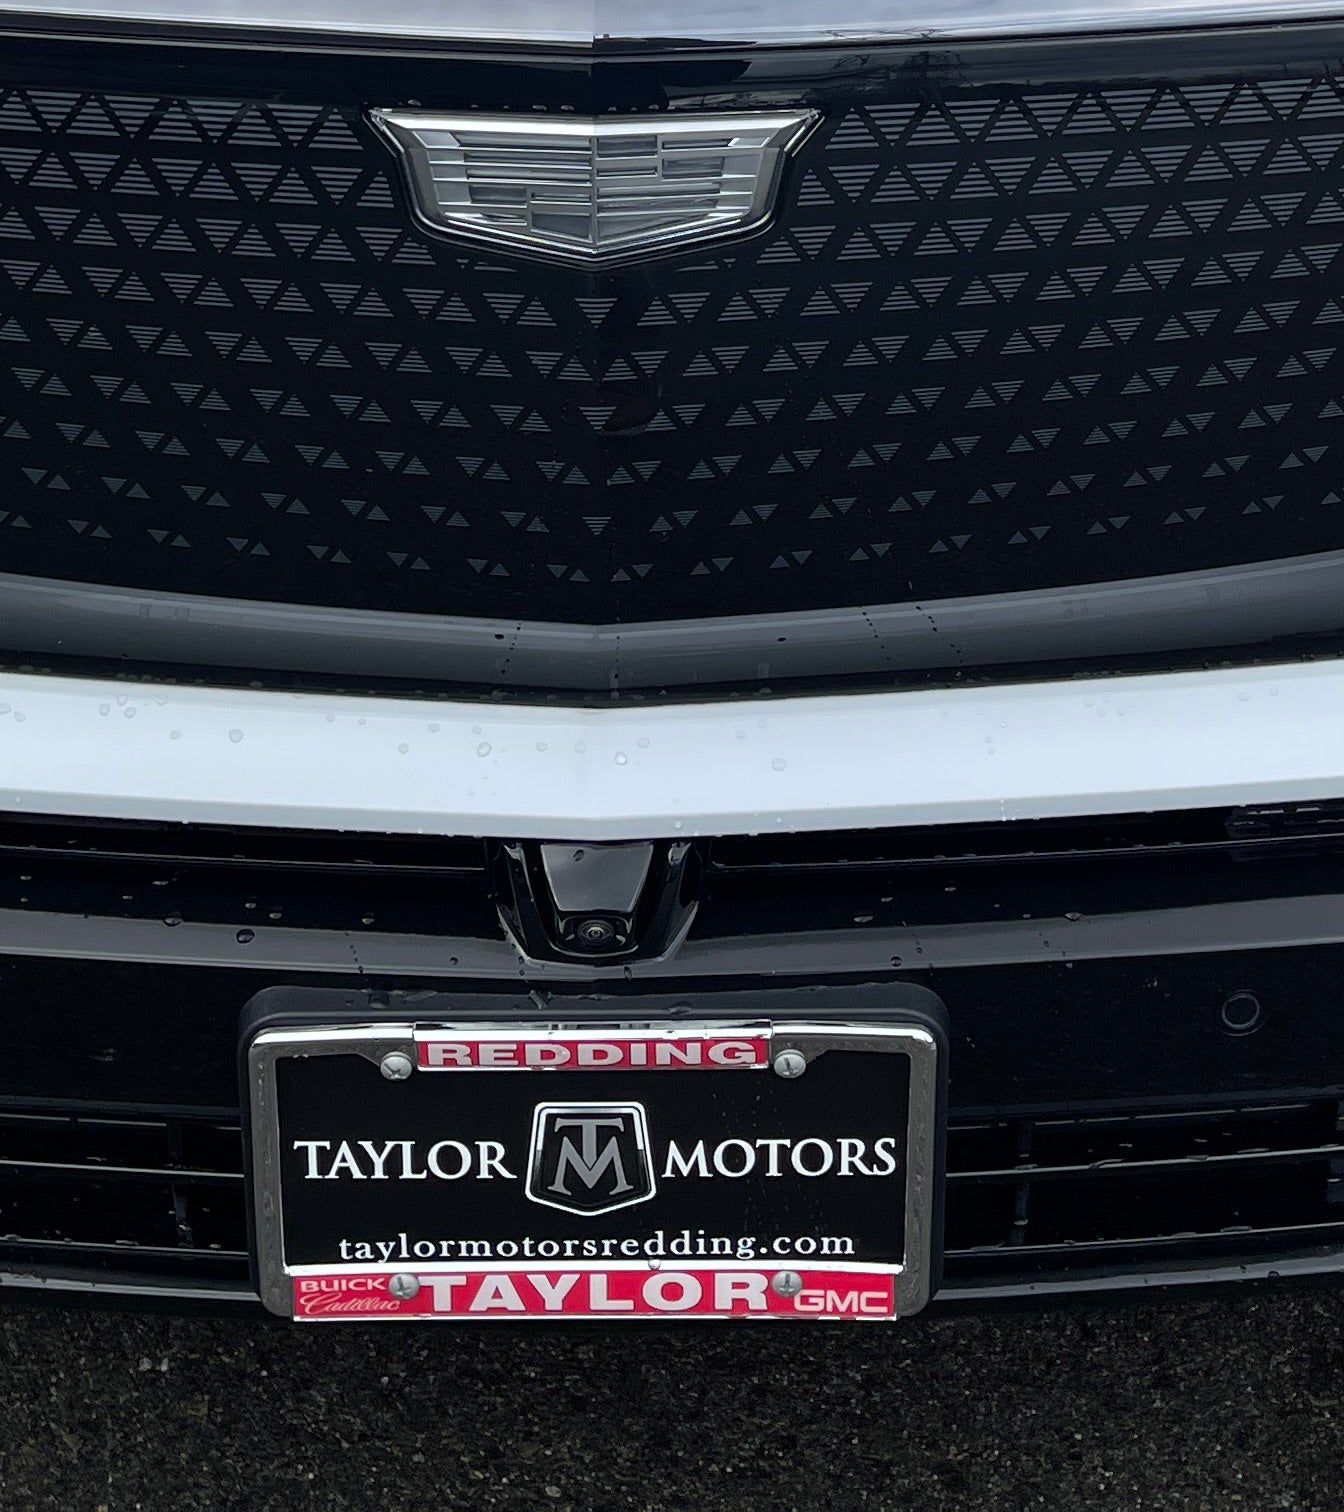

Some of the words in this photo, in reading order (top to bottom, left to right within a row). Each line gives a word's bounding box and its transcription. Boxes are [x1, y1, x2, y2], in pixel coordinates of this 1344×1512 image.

[426, 1040, 757, 1067] REDDING
[293, 1140, 518, 1180] TAYLOR
[661, 1137, 897, 1178] MOTORS
[338, 1229, 856, 1264] taylormotorsredding.com
[300, 1277, 388, 1293] BUICK
[417, 1271, 769, 1312] TAYLOR
[299, 1292, 401, 1315] Cadillac
[793, 1289, 889, 1314] GMC
